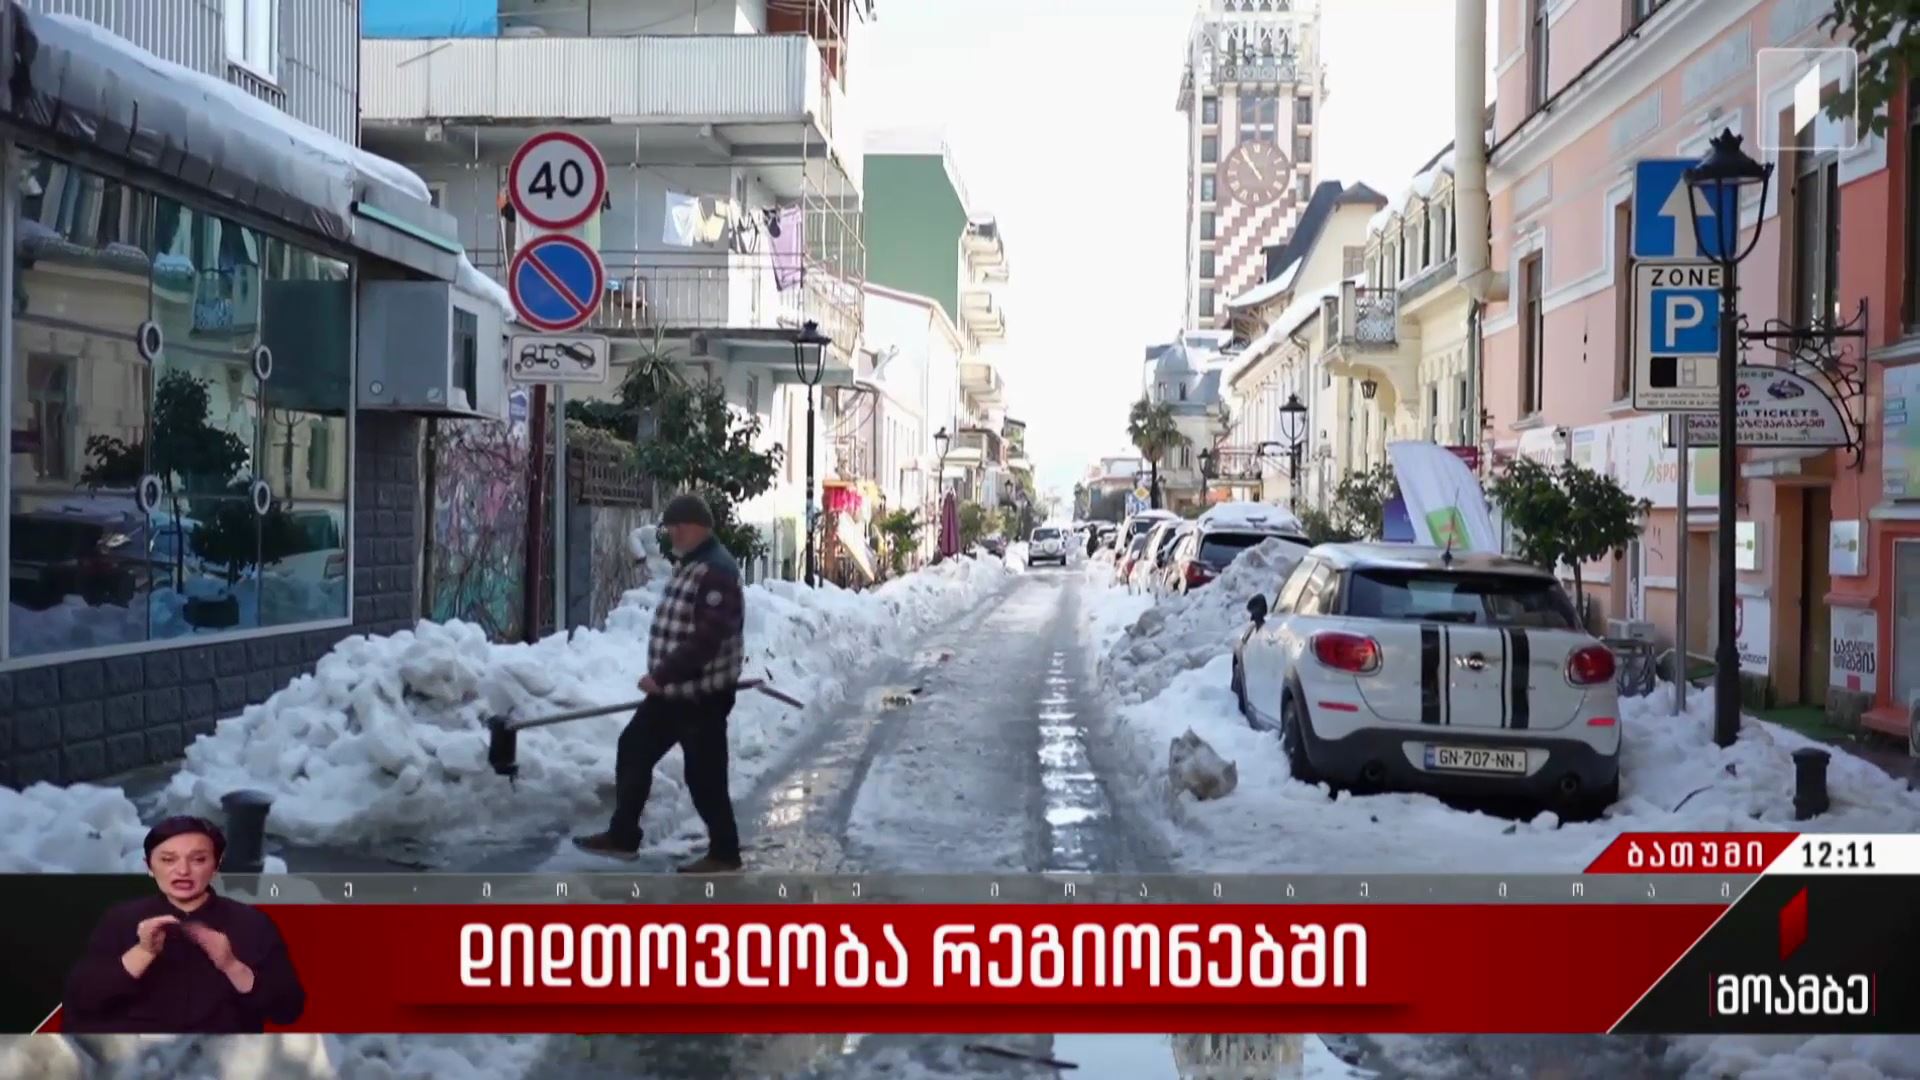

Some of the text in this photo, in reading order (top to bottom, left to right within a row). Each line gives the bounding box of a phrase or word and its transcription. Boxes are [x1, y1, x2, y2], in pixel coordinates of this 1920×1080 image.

[528, 159, 584, 200] 40
[1650, 268, 1721, 287] ZONE
[1665, 295, 1704, 347] P
[1754, 408, 1819, 418] TICKETS
[1438, 748, 1515, 769] GN-707-NN
